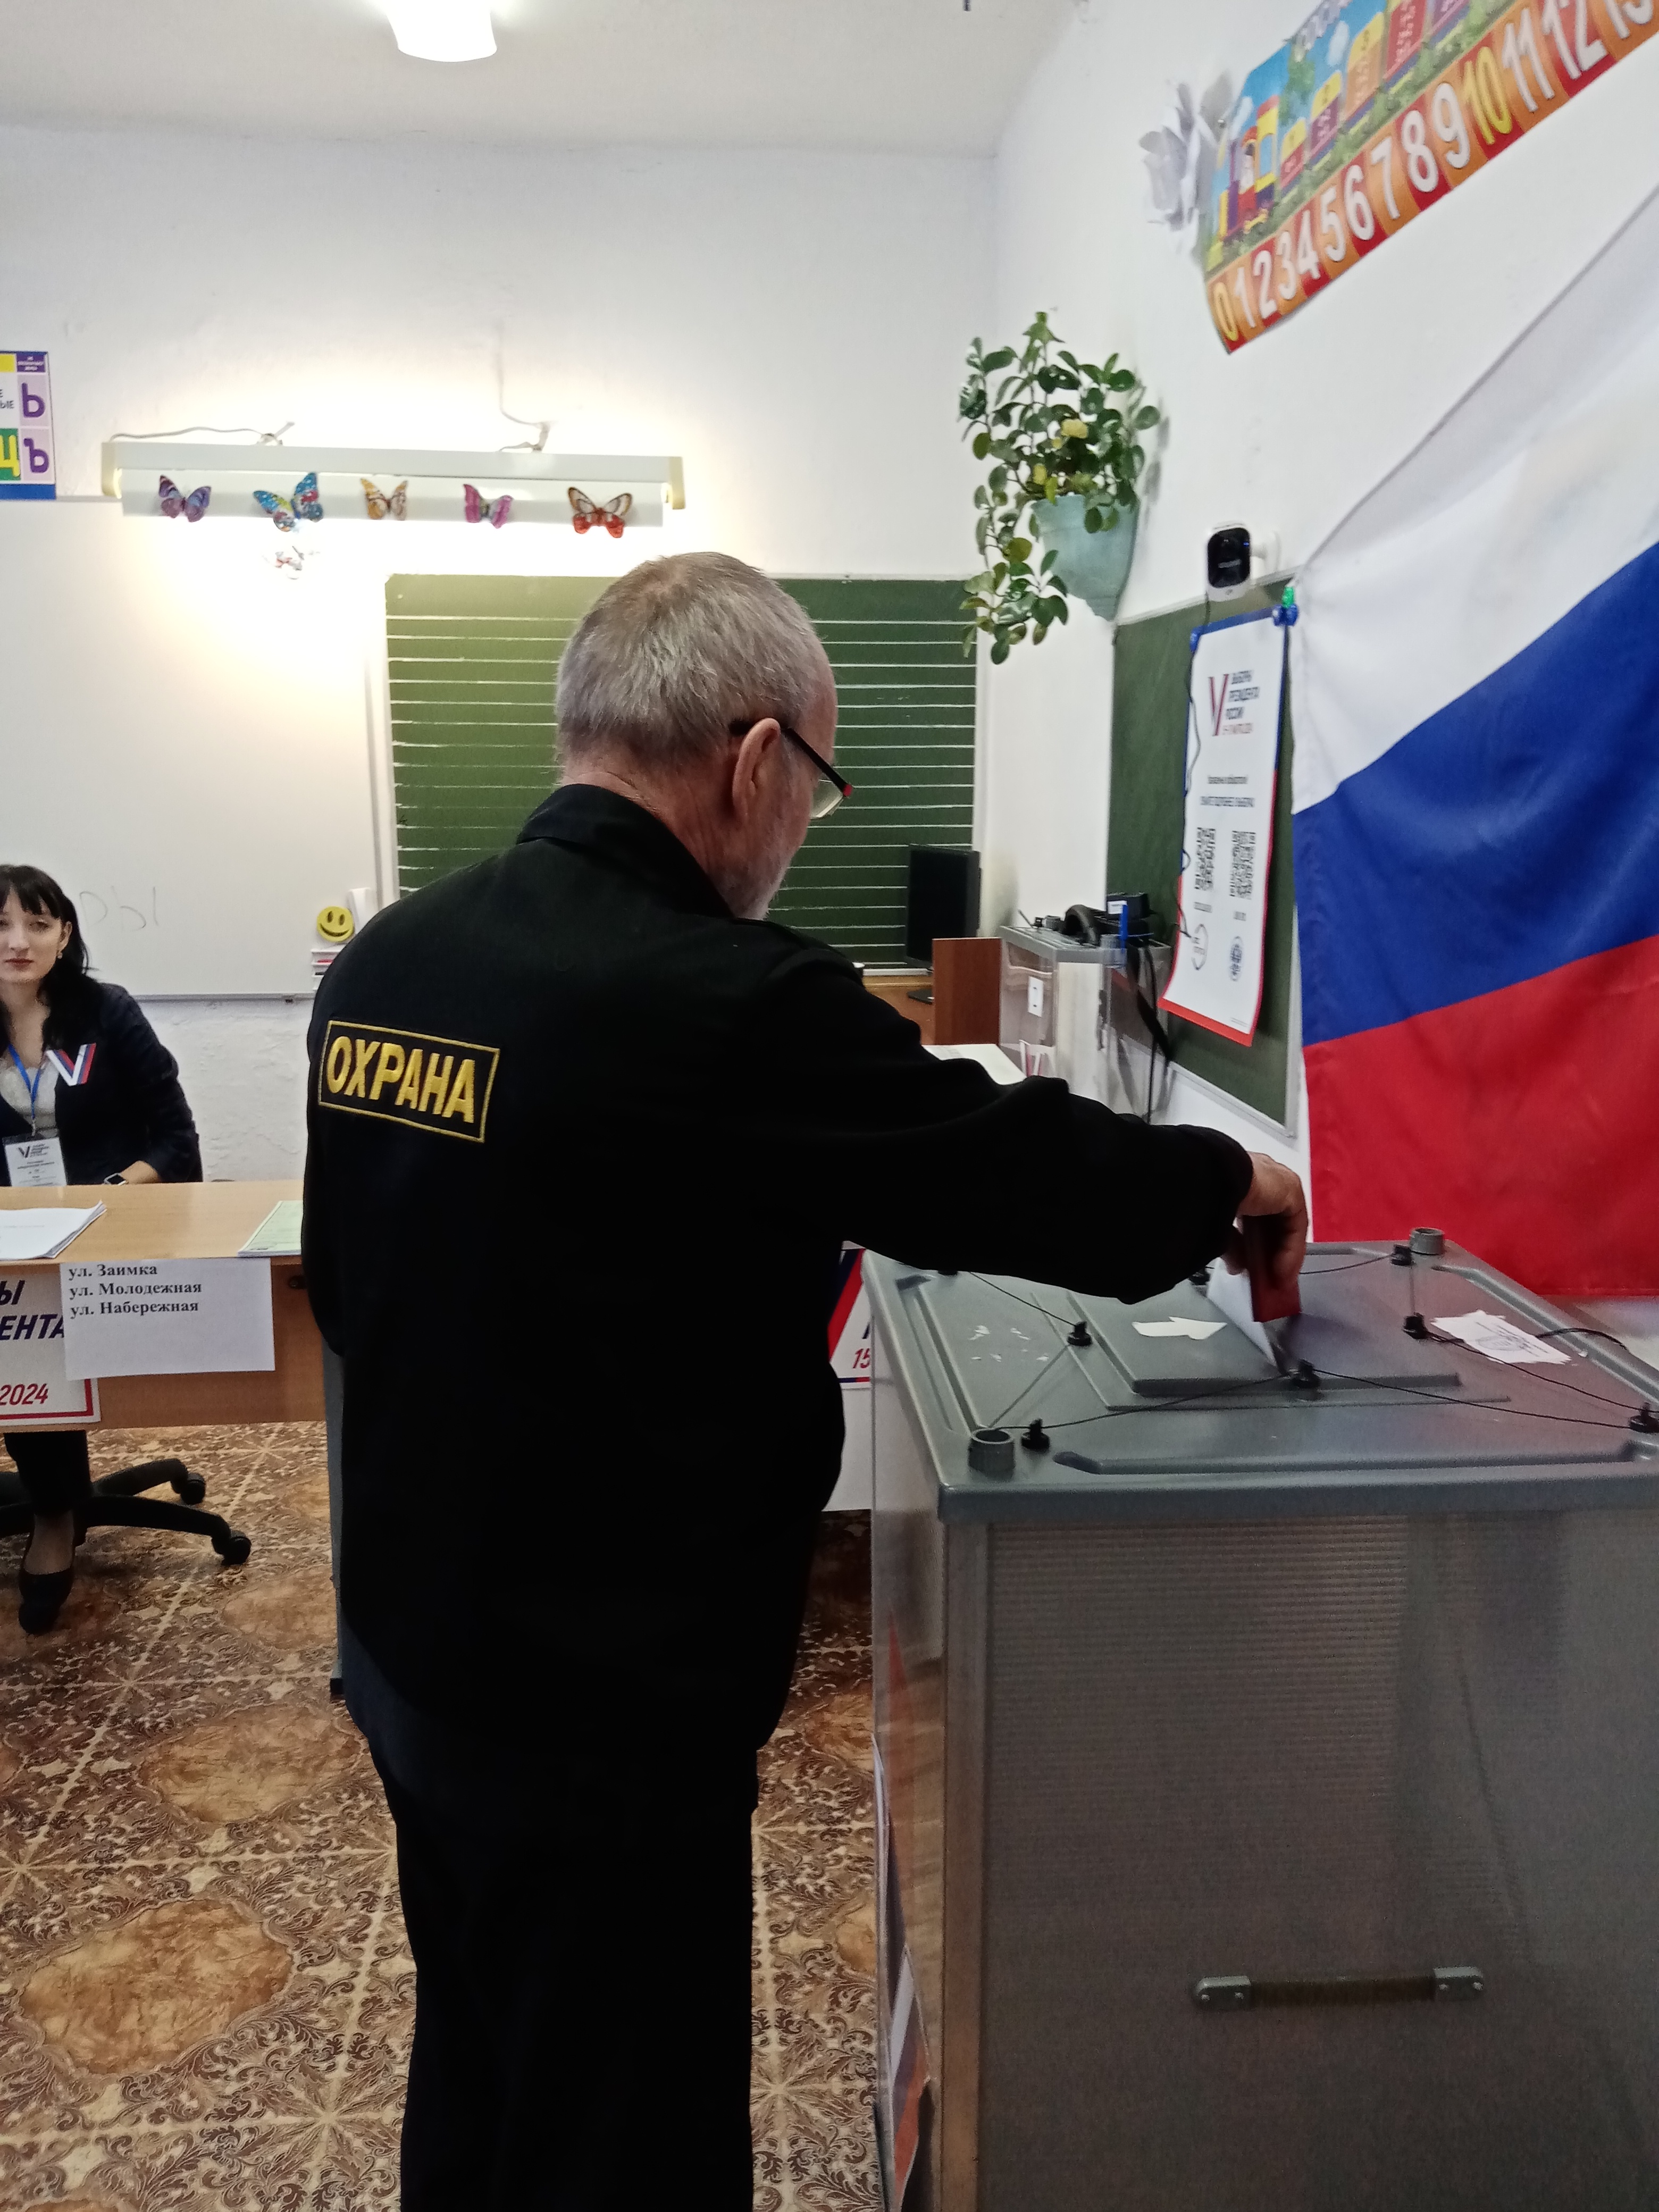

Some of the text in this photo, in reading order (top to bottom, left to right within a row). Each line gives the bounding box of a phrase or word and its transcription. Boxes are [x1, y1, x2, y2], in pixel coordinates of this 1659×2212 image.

[1213, 282, 1238, 341] 0
[1235, 267, 1255, 328] 1
[1253, 250, 1277, 319] 2
[1276, 230, 1296, 300] 3
[1297, 210, 1321, 279] 4
[1320, 187, 1346, 262] 5
[1344, 165, 1375, 241] 6
[1371, 136, 1401, 220] 7
[1401, 110, 1438, 192] 8
[1431, 82, 1470, 169] 9
[1463, 46, 1512, 145] 10
[1502, 7, 1555, 113] 11
[326, 1036, 475, 1124] ОХРАНА
[69, 1264, 157, 1280] ул. Заимка
[69, 1283, 202, 1300] ул. Молодежная
[70, 1301, 199, 1319] ул. Набережная
[0, 1384, 48, 1405] 2024
